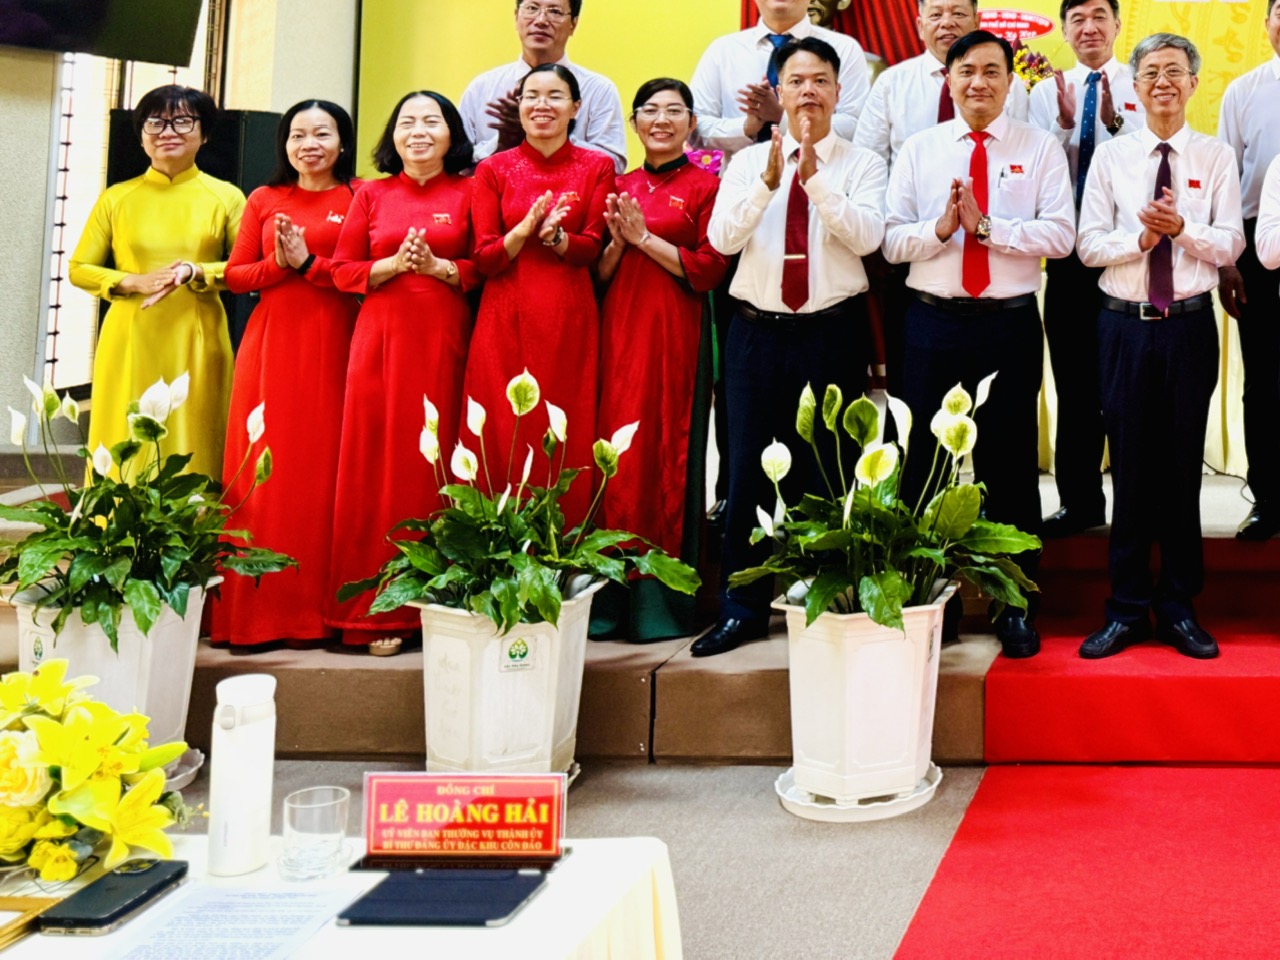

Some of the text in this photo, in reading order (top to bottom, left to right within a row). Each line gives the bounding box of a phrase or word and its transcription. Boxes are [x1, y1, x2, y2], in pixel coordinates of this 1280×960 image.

[437, 783, 495, 796] ĐỒNG CHÍ
[379, 798, 550, 823] LÊ HOÀNG HẢI
